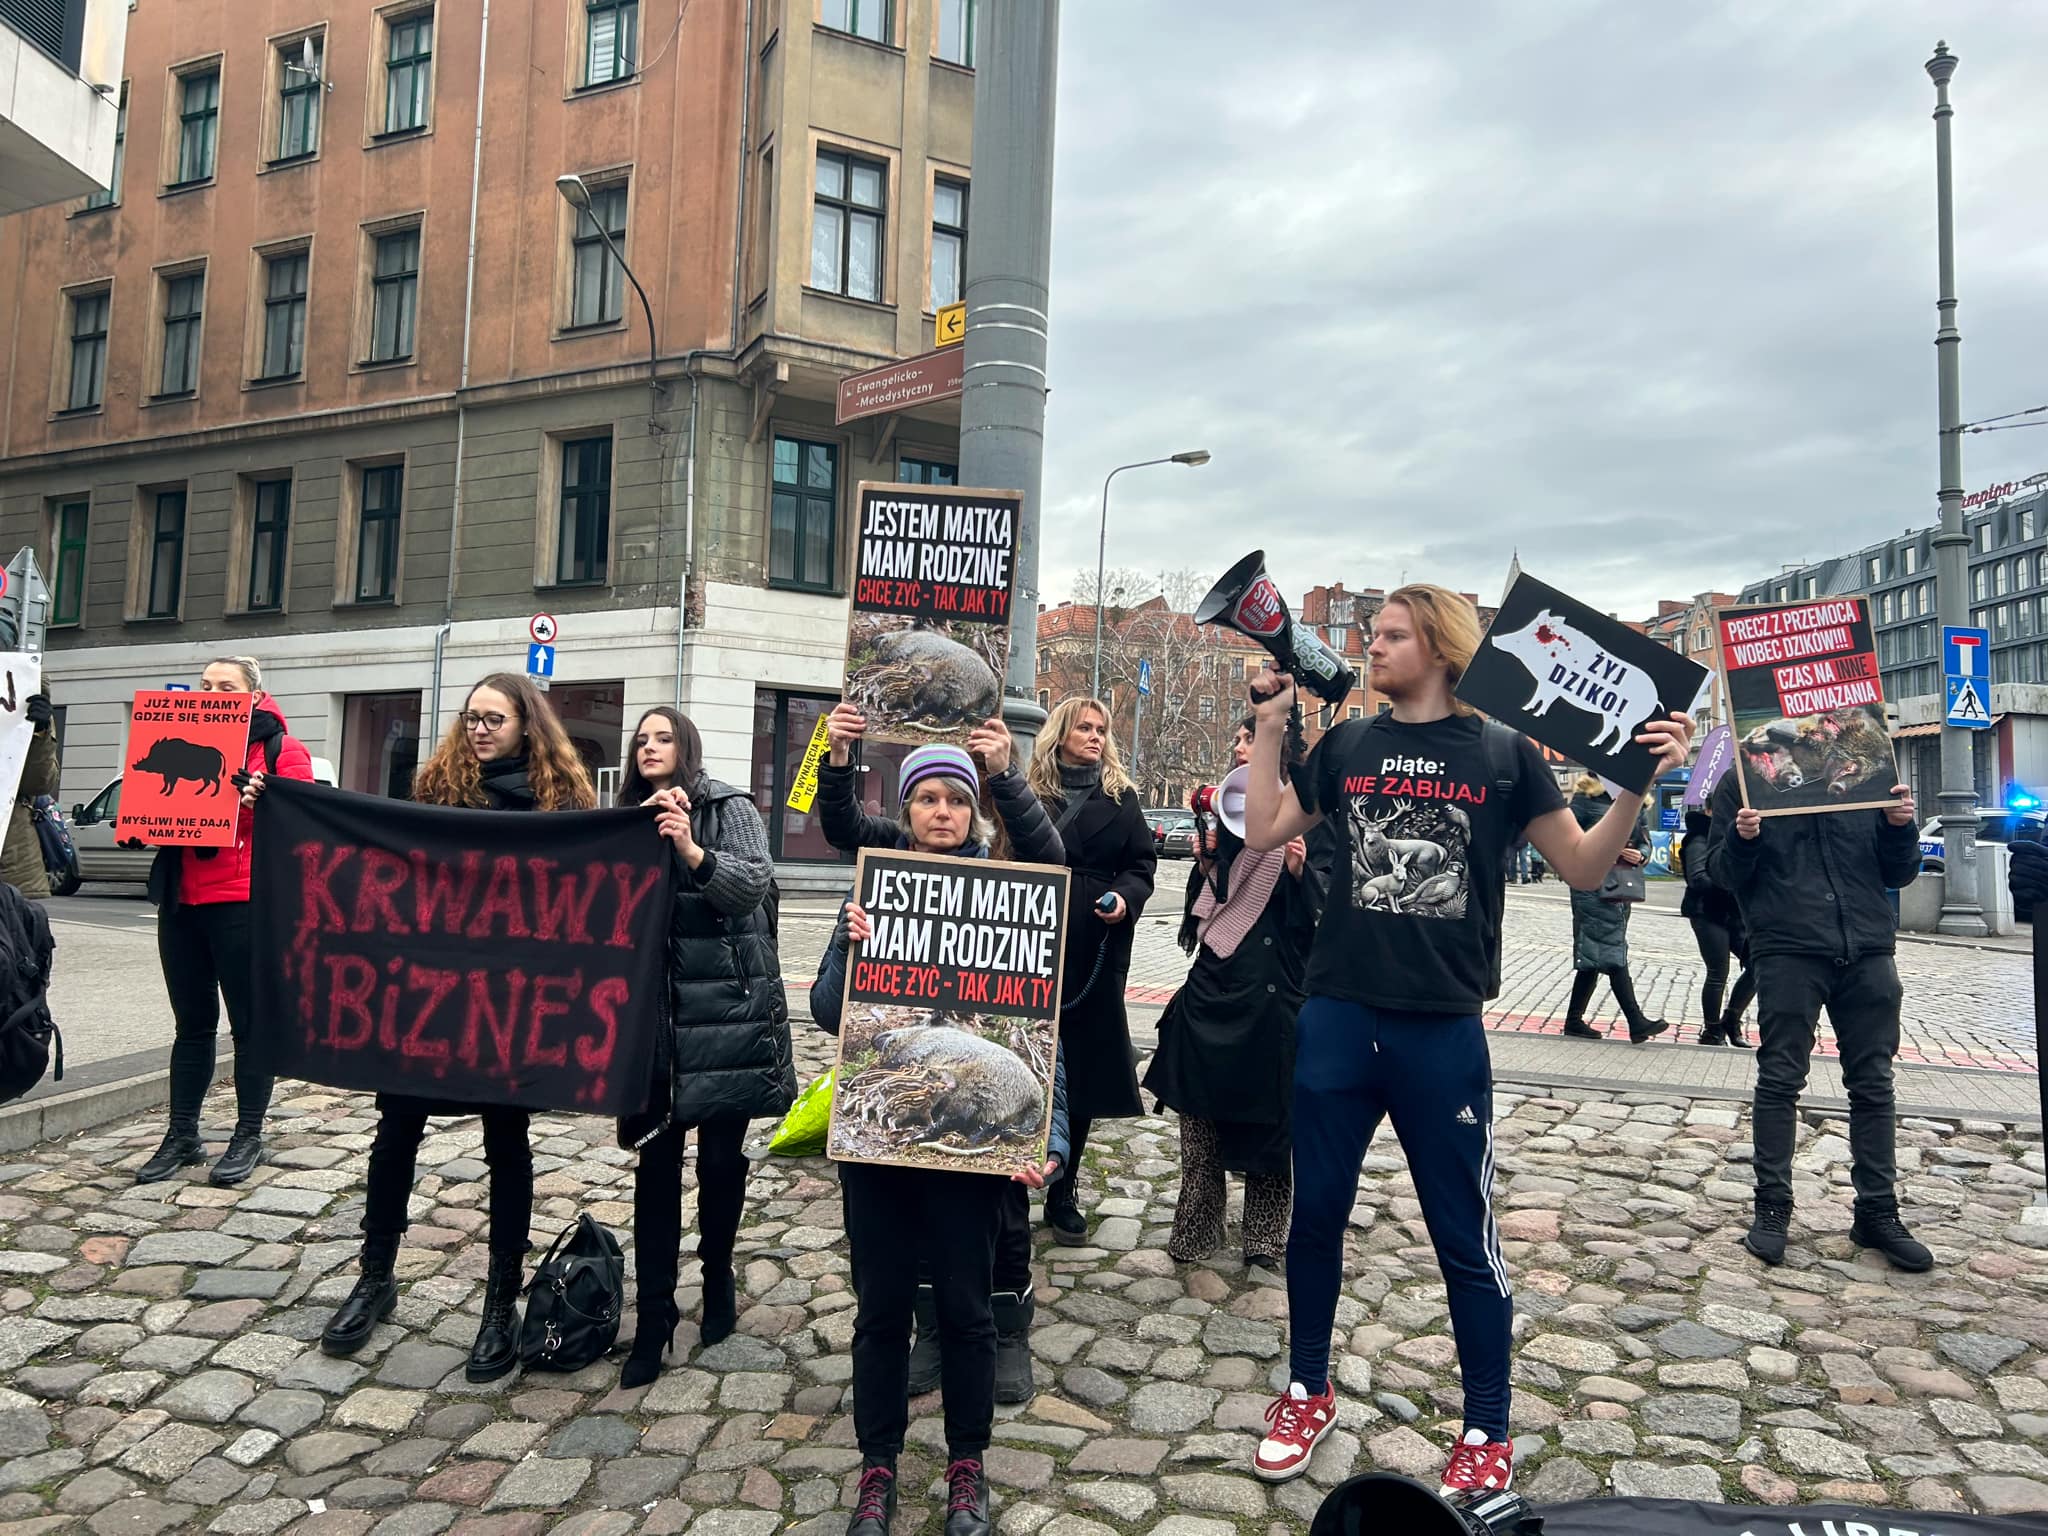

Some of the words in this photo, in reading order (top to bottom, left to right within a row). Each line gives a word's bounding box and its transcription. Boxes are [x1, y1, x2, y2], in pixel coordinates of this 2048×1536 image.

[855, 382, 934, 408] -Metodystyczny
[857, 370, 922, 393] Ewangelicko-
[1962, 482, 2013, 508] ampton
[864, 500, 939, 540] JESTEM
[943, 505, 1012, 548] MATKĄ
[861, 539, 915, 579] MAM
[919, 543, 1010, 591] RODZINĘ
[857, 578, 893, 607] CHCĘ
[894, 580, 921, 608] ŻYĆ
[933, 585, 959, 611] TAK
[960, 588, 988, 614] JAK
[990, 590, 1009, 616] TY
[1254, 583, 1280, 616] STOP
[1727, 615, 1771, 643] PRECZ
[1771, 613, 1782, 635] Z
[1782, 602, 1855, 632] PRZEMOCĄ
[1733, 639, 1782, 666] WOBEC
[1782, 628, 1849, 658] DZIKÓW!!!
[1588, 651, 1628, 686] ŻYJ
[1777, 665, 1813, 690] CZAS
[1812, 662, 1836, 684] NA
[1835, 656, 1870, 680] INNE
[144, 697, 171, 710] JUŻ
[173, 699, 198, 710] NIE
[200, 699, 241, 710] MAMY
[1549, 663, 1629, 718] DZIKO!
[1783, 681, 1878, 715] ROZWIĄZANIA
[133, 712, 175, 723] GDZIE
[178, 712, 200, 725] SIĘ
[203, 711, 249, 723] SKRYĆ
[796, 743, 820, 788] WYNAJĘCIA
[1381, 755, 1446, 776] piąte:
[1699, 731, 1731, 799] PARKING
[791, 791, 802, 804] DO
[1344, 776, 1377, 793] NIE
[1382, 777, 1487, 804] ZABIJAJ
[121, 815, 173, 827] MYŚLIWI
[176, 817, 197, 827] NIE
[200, 817, 231, 829] DAJĄ
[148, 828, 175, 838] NAM
[178, 826, 203, 839] ŻYĆ
[292, 840, 662, 949] KRWAWY
[865, 869, 965, 917] JESTEM
[970, 877, 1057, 930] MATKĄ
[861, 914, 933, 963] MAM
[938, 920, 1056, 979] RODZINĘ
[855, 961, 903, 997] CHCĘ
[904, 964, 941, 998] ŻYĆ
[957, 971, 991, 1002] TAK
[992, 975, 1027, 1006] JAK
[1031, 978, 1054, 1009] TY
